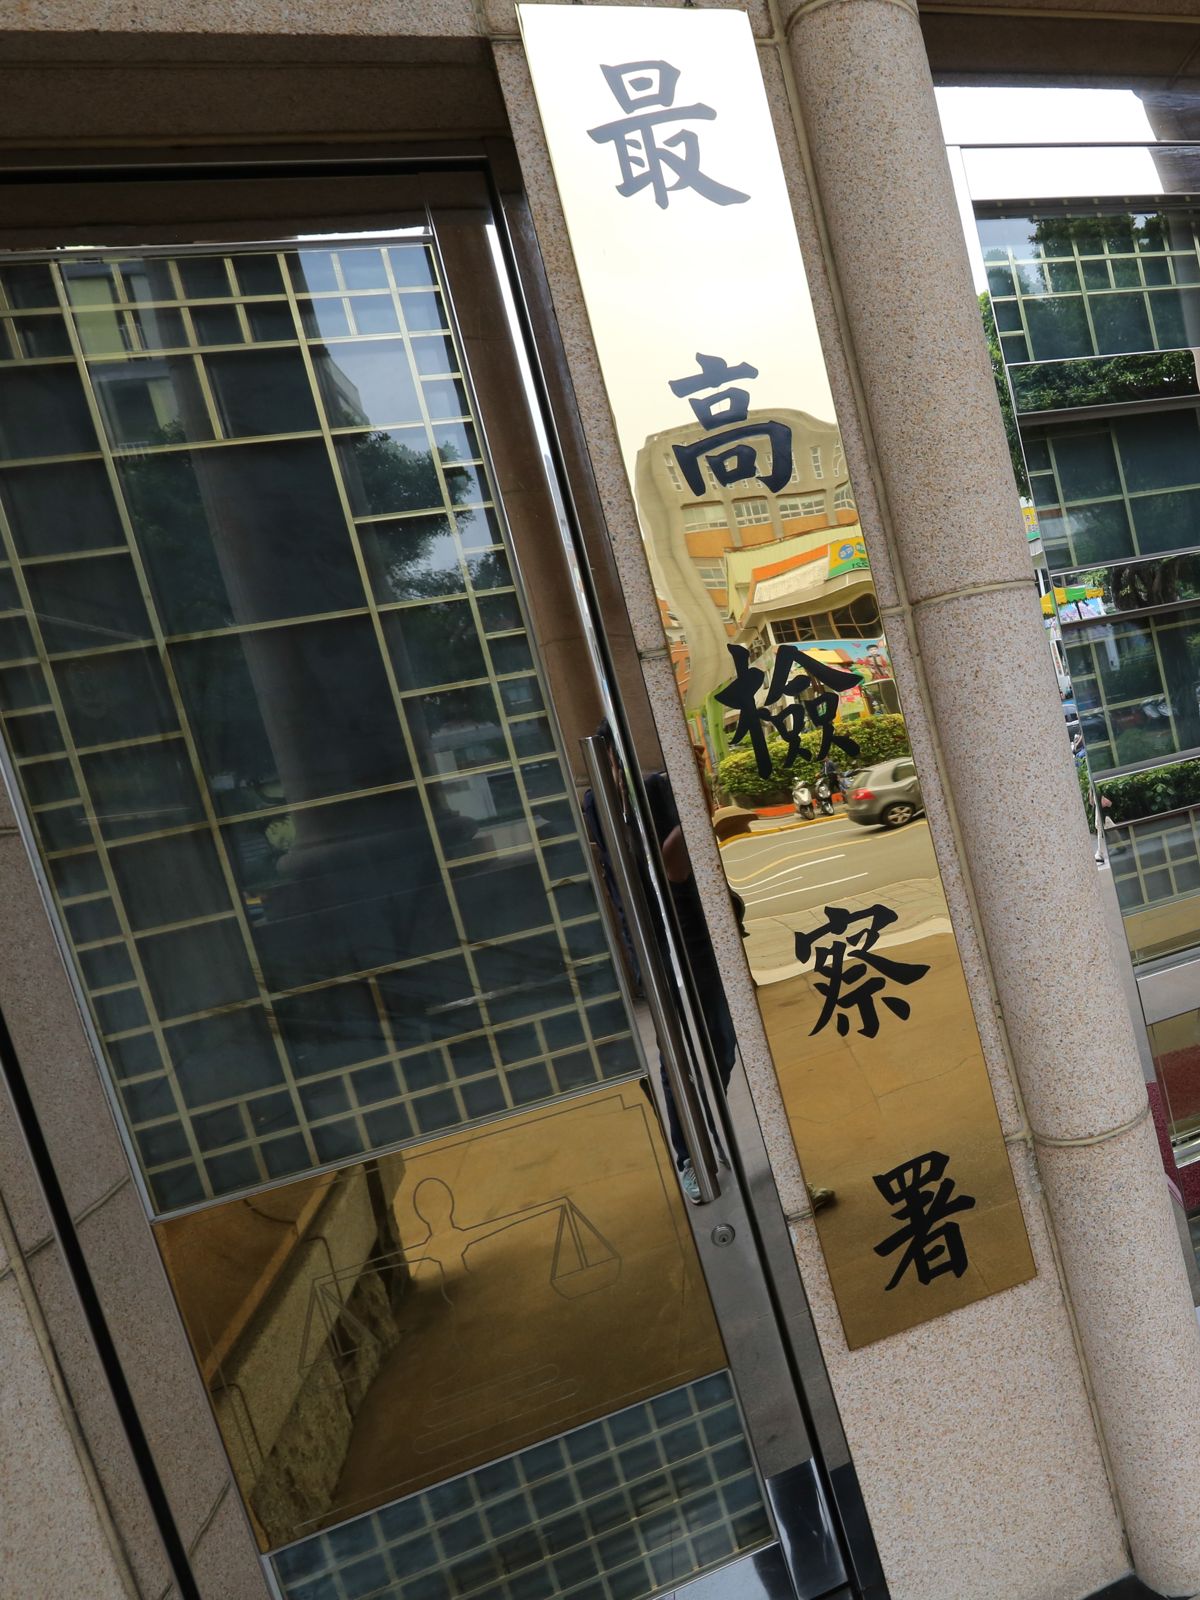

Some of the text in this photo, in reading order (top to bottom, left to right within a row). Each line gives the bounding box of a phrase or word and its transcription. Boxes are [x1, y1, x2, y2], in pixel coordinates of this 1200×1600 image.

[587, 60, 976, 1291] 最高檢察署
